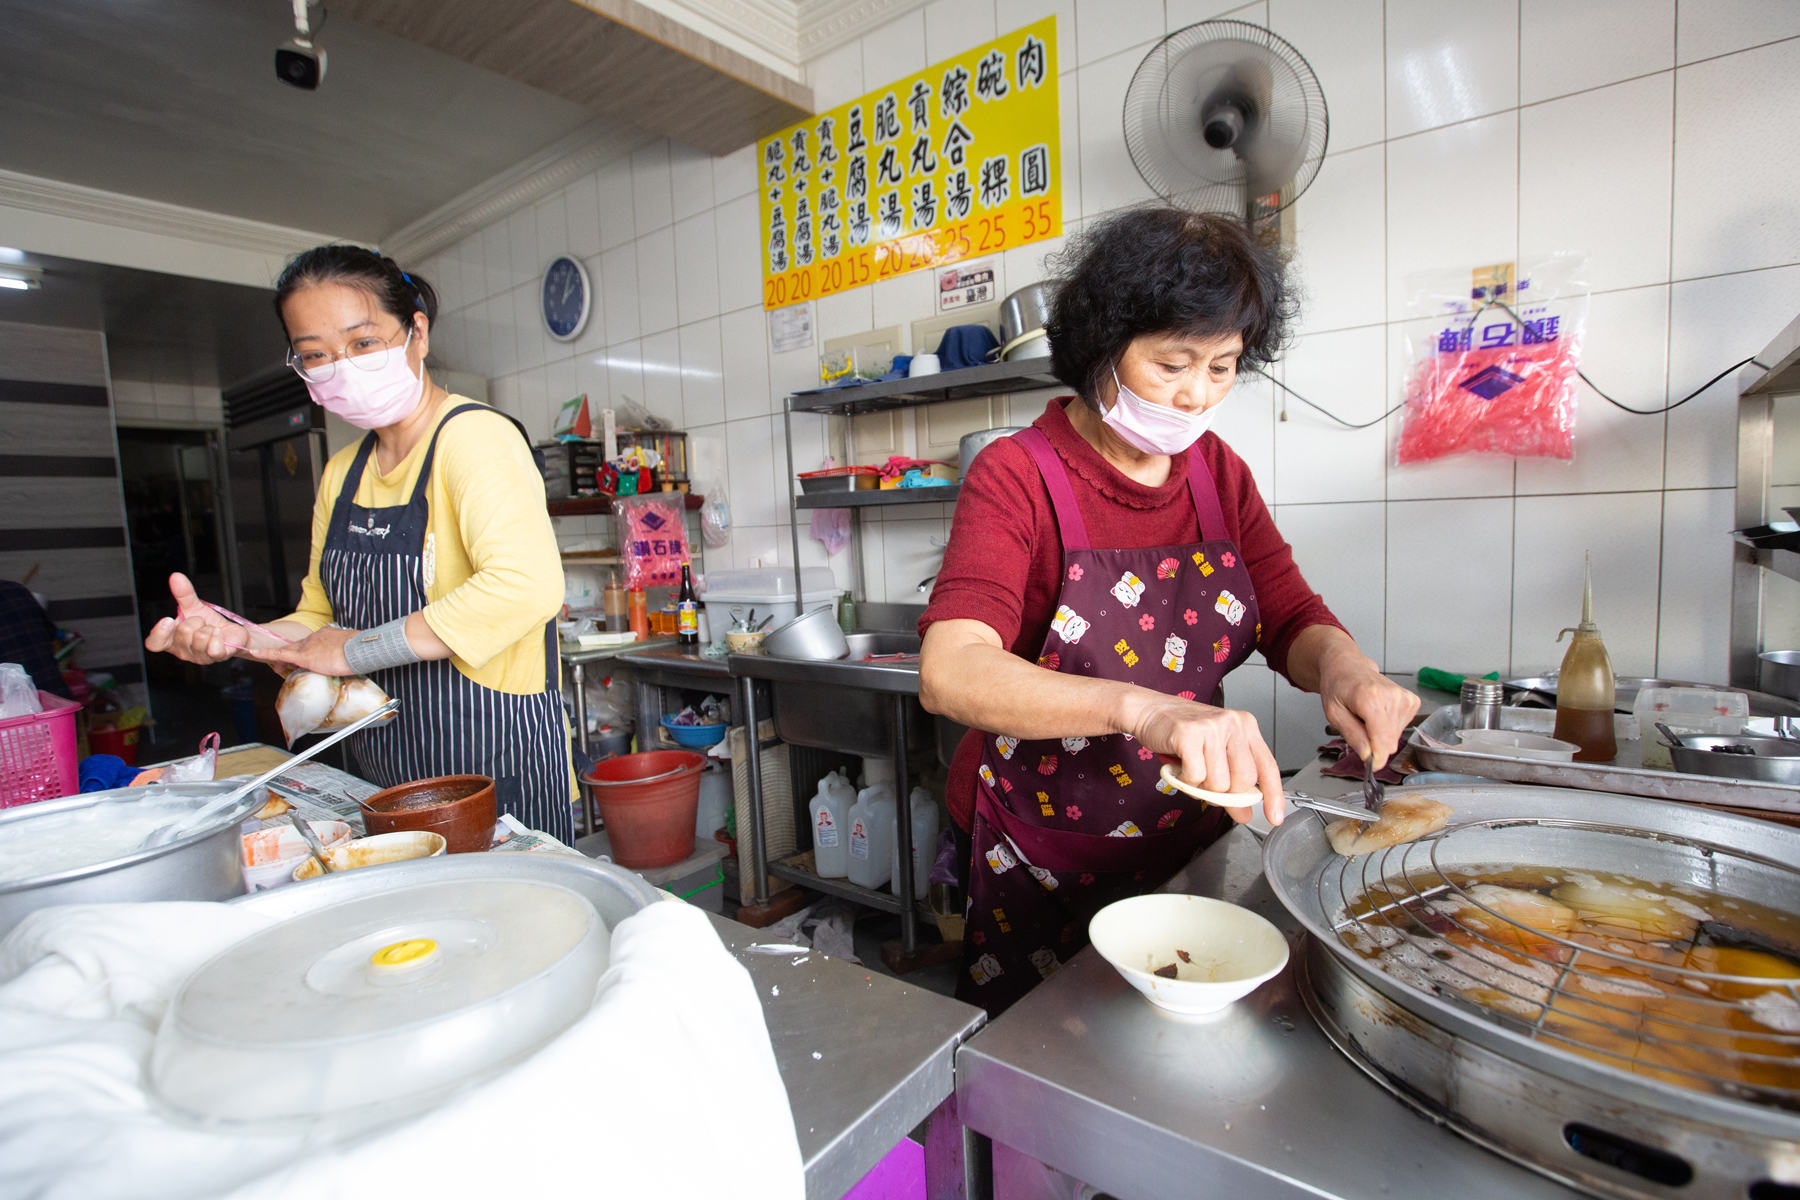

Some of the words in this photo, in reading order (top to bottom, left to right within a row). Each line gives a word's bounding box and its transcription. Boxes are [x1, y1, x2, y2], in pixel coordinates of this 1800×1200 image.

[847, 105, 870, 244] 豆腐湯
[875, 96, 902, 236] 脆丸湯
[908, 83, 936, 227] 貢丸湯
[942, 68, 972, 217] 綜合湯
[977, 53, 1008, 206] 碗粿
[1019, 37, 1047, 194] 肉圓
[767, 277, 786, 306] 20
[791, 270, 811, 300] 20
[821, 261, 842, 292] 20
[848, 252, 870, 285] 15
[879, 244, 904, 276] 20
[909, 234, 934, 268] 20
[944, 224, 971, 260] 25
[978, 214, 1006, 251] 25
[1022, 201, 1051, 239] 35
